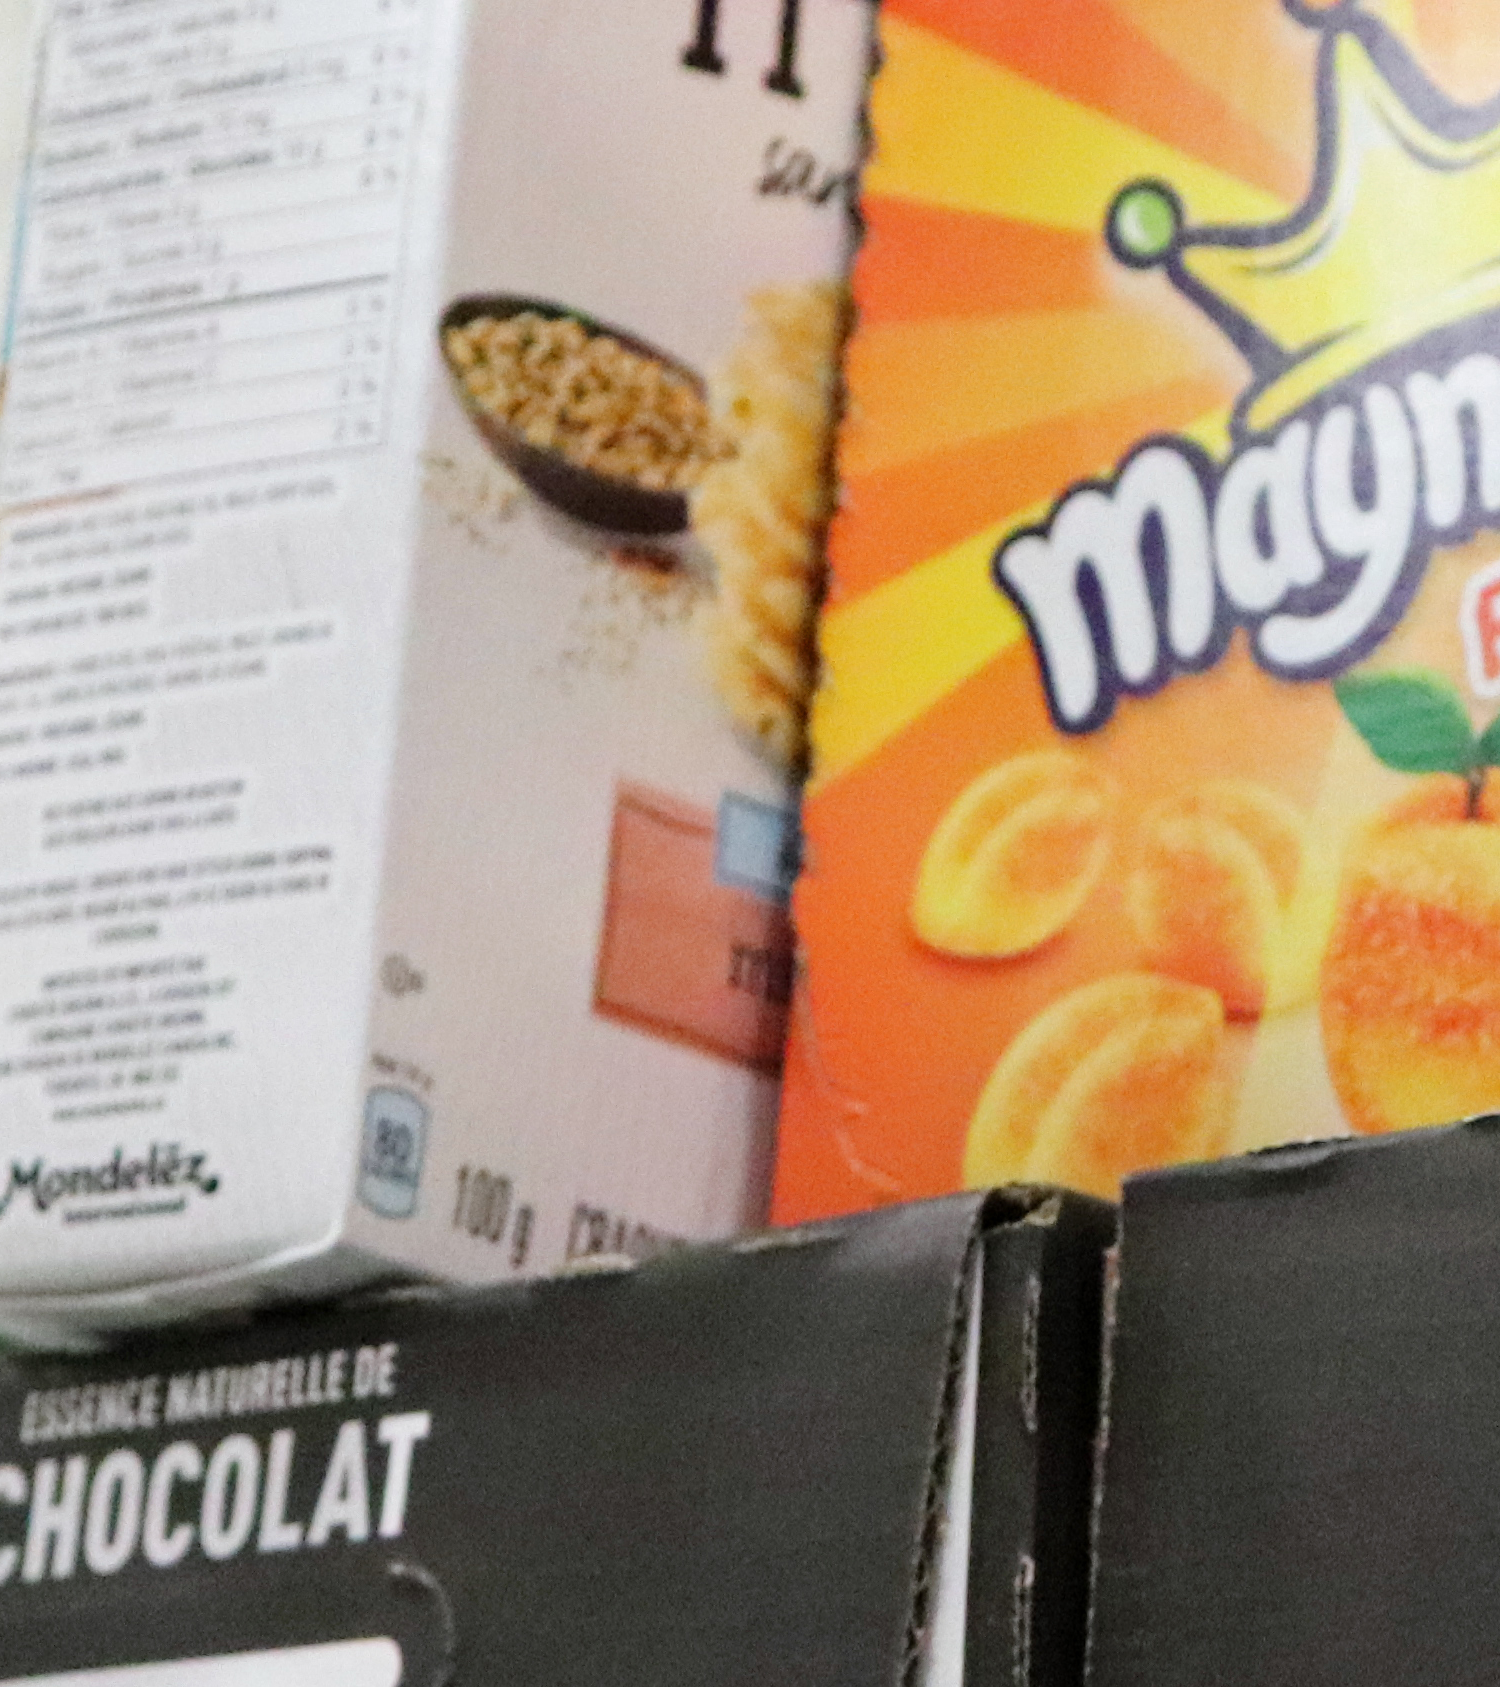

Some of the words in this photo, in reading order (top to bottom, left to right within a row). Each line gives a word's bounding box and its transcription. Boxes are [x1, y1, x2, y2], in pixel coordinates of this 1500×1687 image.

[20, 1372, 164, 1444] ESSENCE
[165, 1348, 346, 1425] NATURELLE
[353, 1343, 400, 1398] DE
